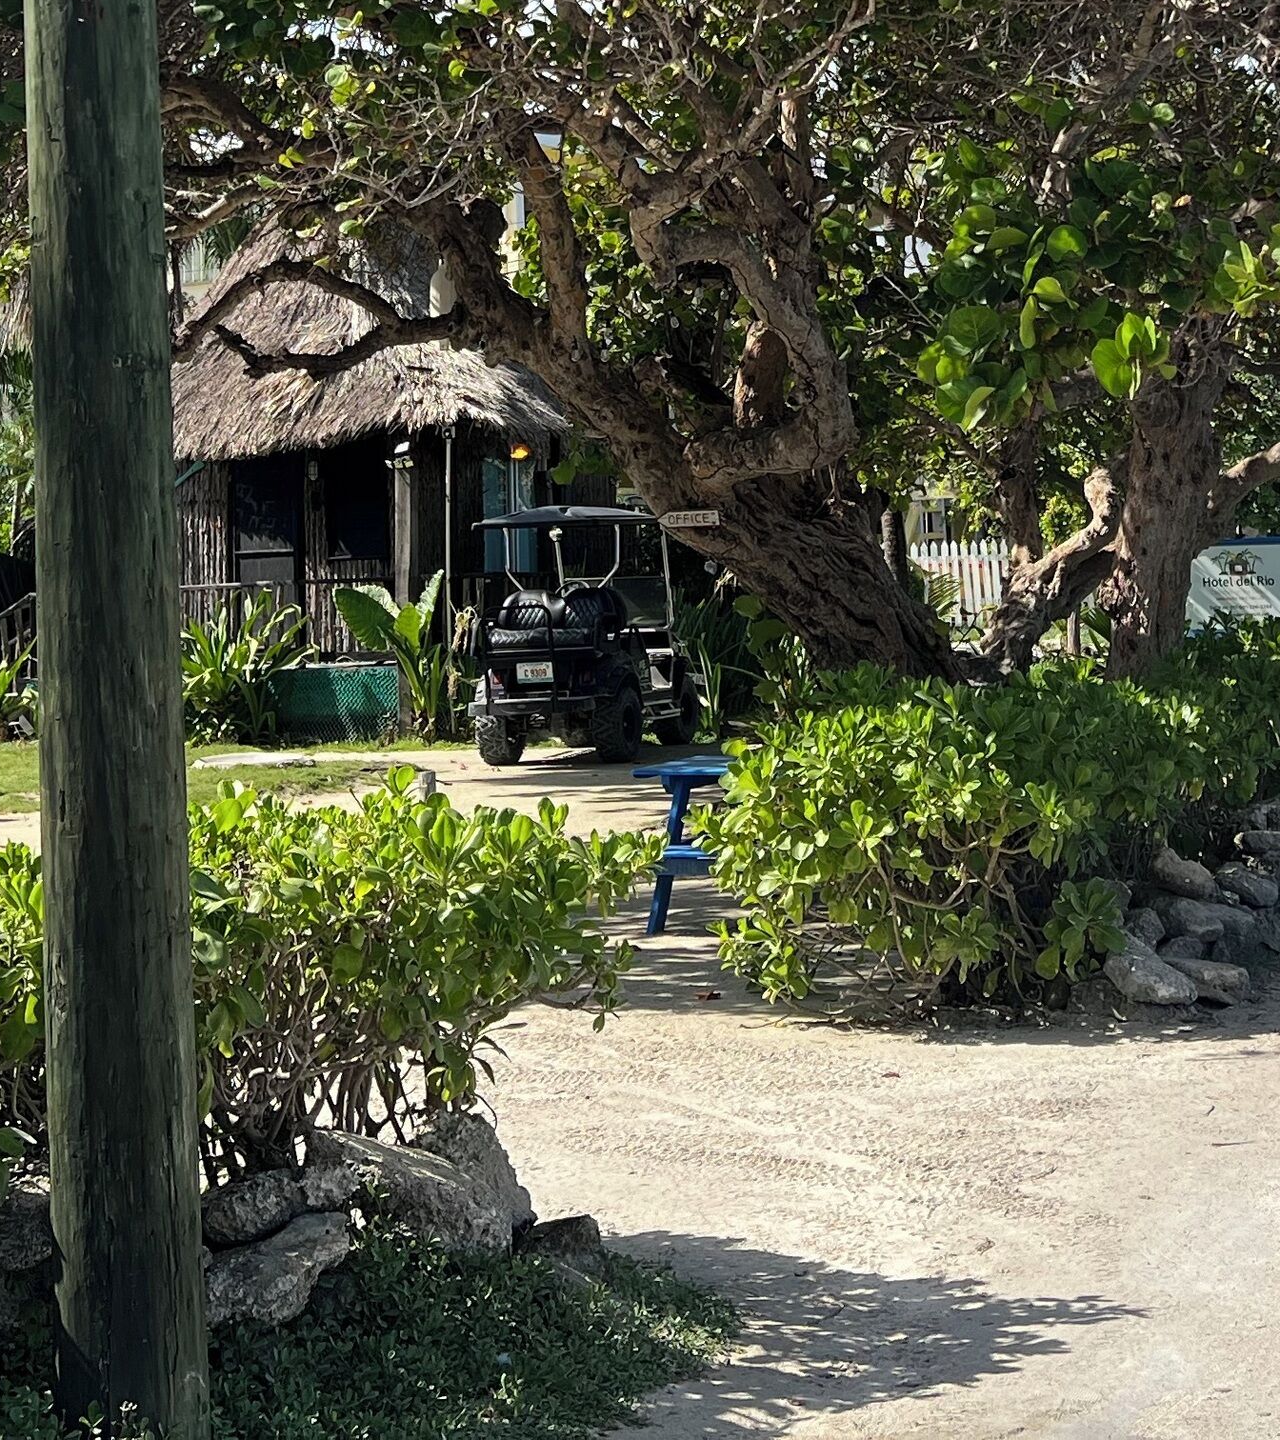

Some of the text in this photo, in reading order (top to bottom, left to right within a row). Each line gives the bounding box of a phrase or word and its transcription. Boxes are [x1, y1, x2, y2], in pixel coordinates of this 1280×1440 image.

[668, 512, 710, 525] OFFICE
[1202, 575, 1275, 588] Hotel del Rio
